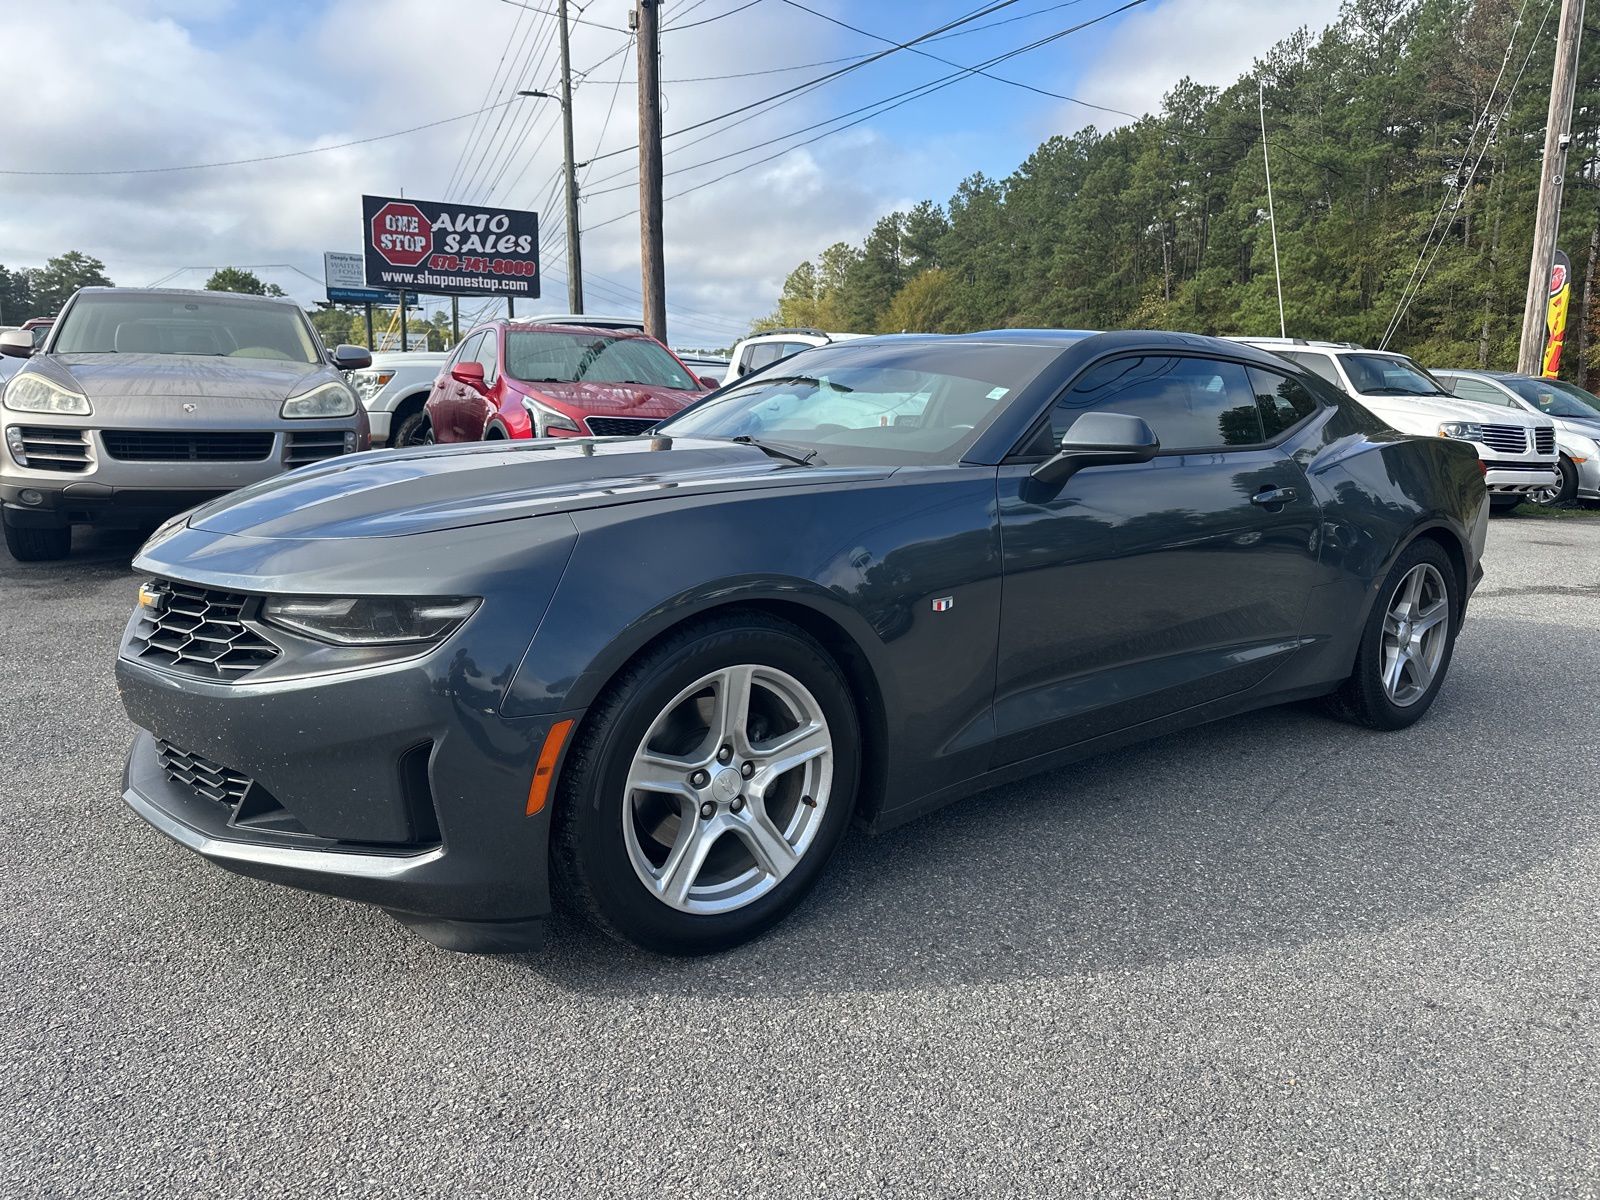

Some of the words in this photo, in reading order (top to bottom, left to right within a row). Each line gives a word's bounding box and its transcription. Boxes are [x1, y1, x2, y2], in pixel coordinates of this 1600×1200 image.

[385, 214, 419, 233] ONE
[431, 213, 510, 233] AUTO
[380, 233, 426, 253] STOP
[443, 234, 532, 254] SALES
[428, 253, 536, 277] 478-741-8009
[381, 270, 529, 291] www.shoponestop.com
